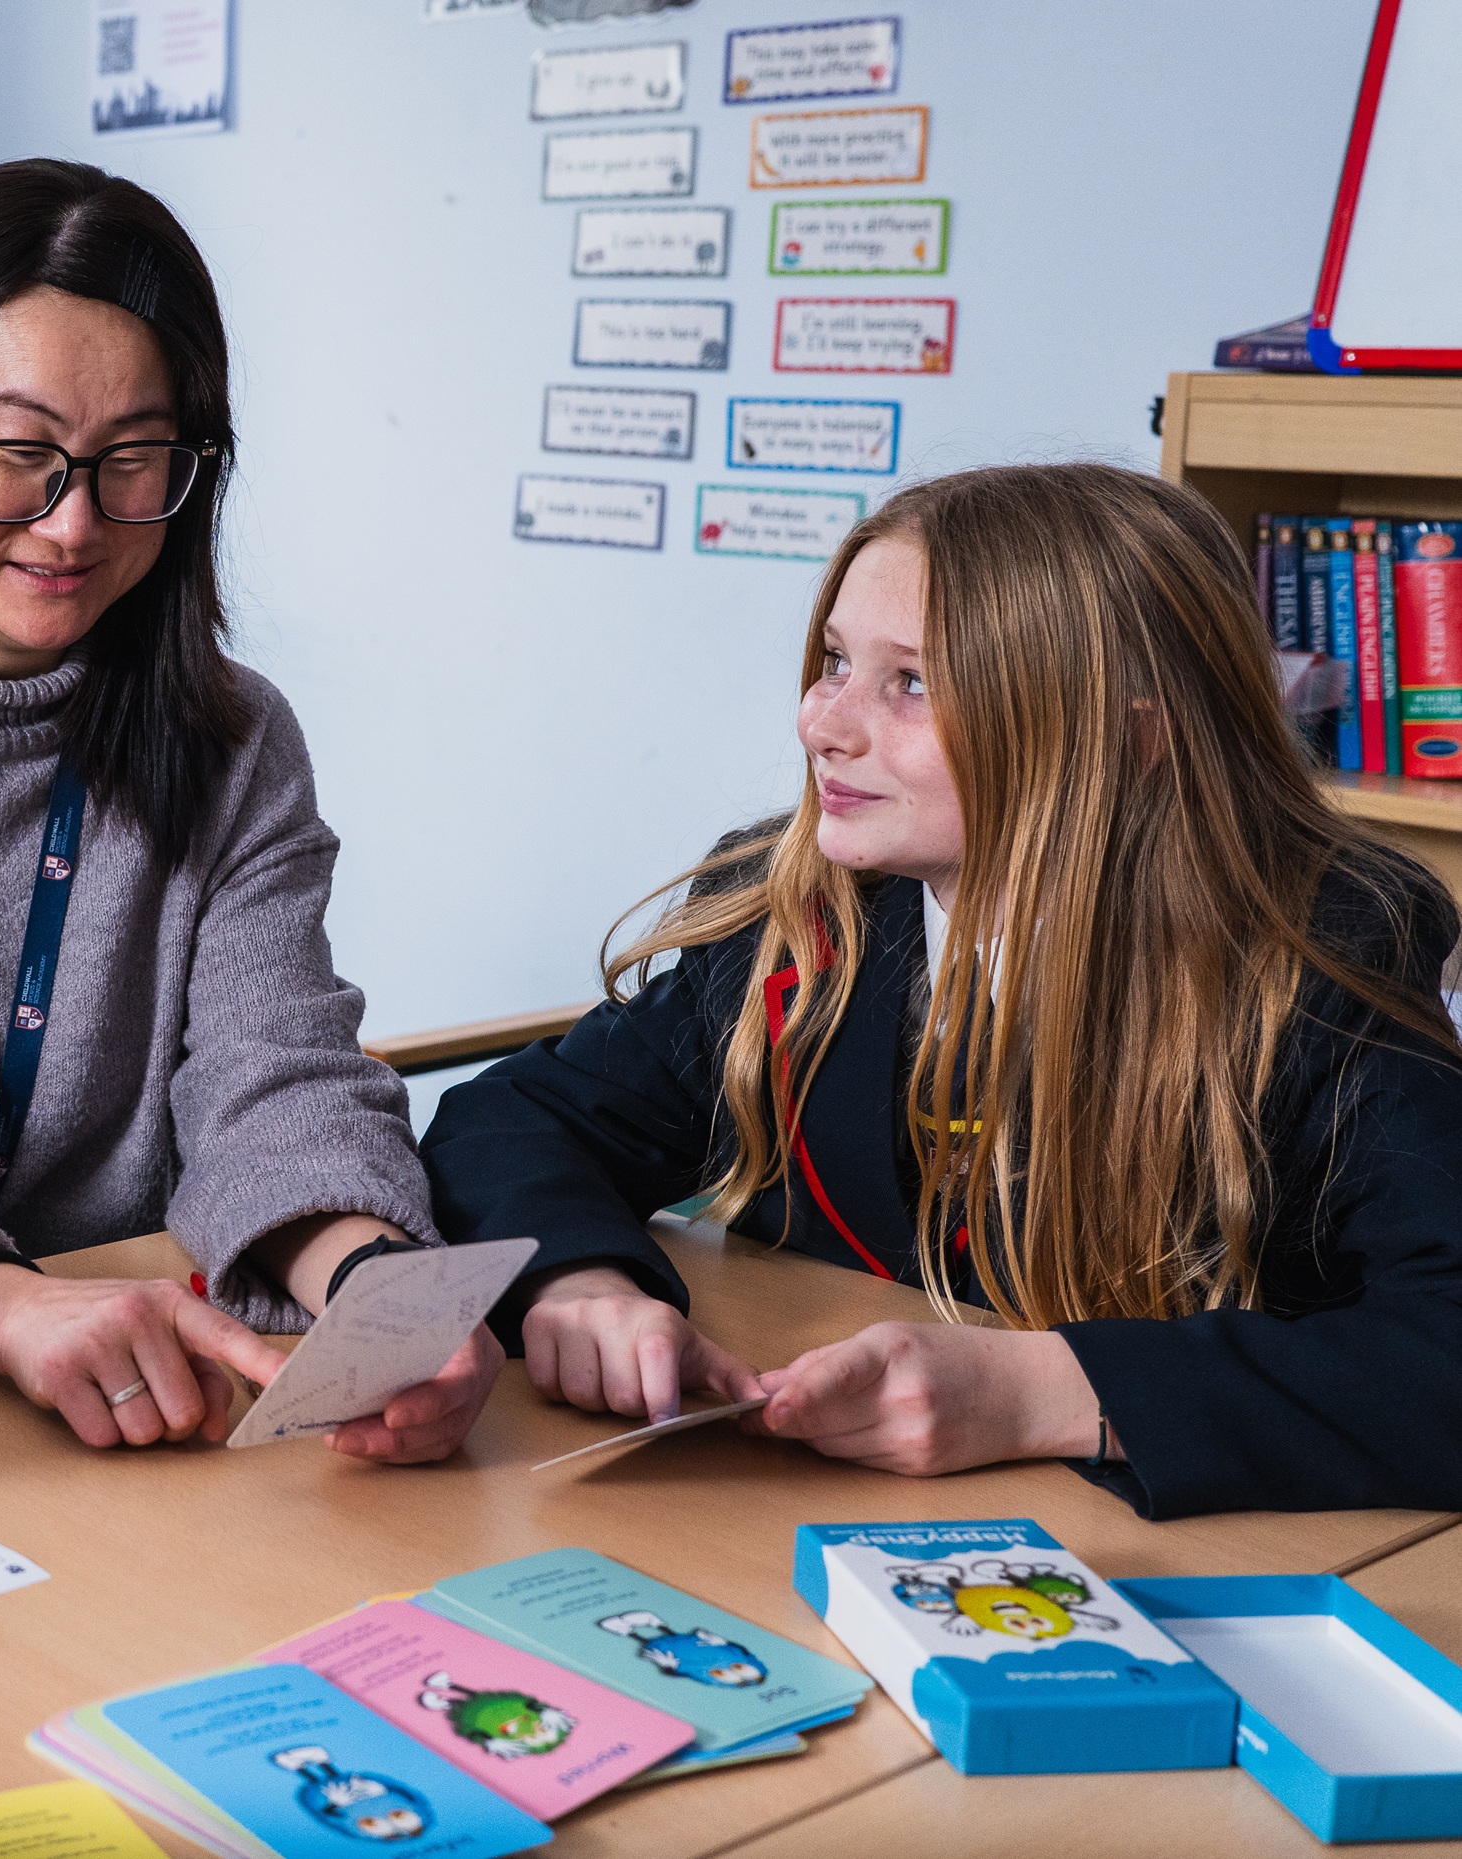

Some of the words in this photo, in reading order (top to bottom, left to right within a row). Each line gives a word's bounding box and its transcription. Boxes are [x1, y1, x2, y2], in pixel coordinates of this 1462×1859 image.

[1424, 567, 1447, 678] CHAMBERS
[1359, 626, 1380, 701] ENGLISH
[49, 816, 60, 853] CHILDWALL
[21, 965, 33, 1002] CHILDWALL
[848, 1527, 1028, 1545] HappySnap
